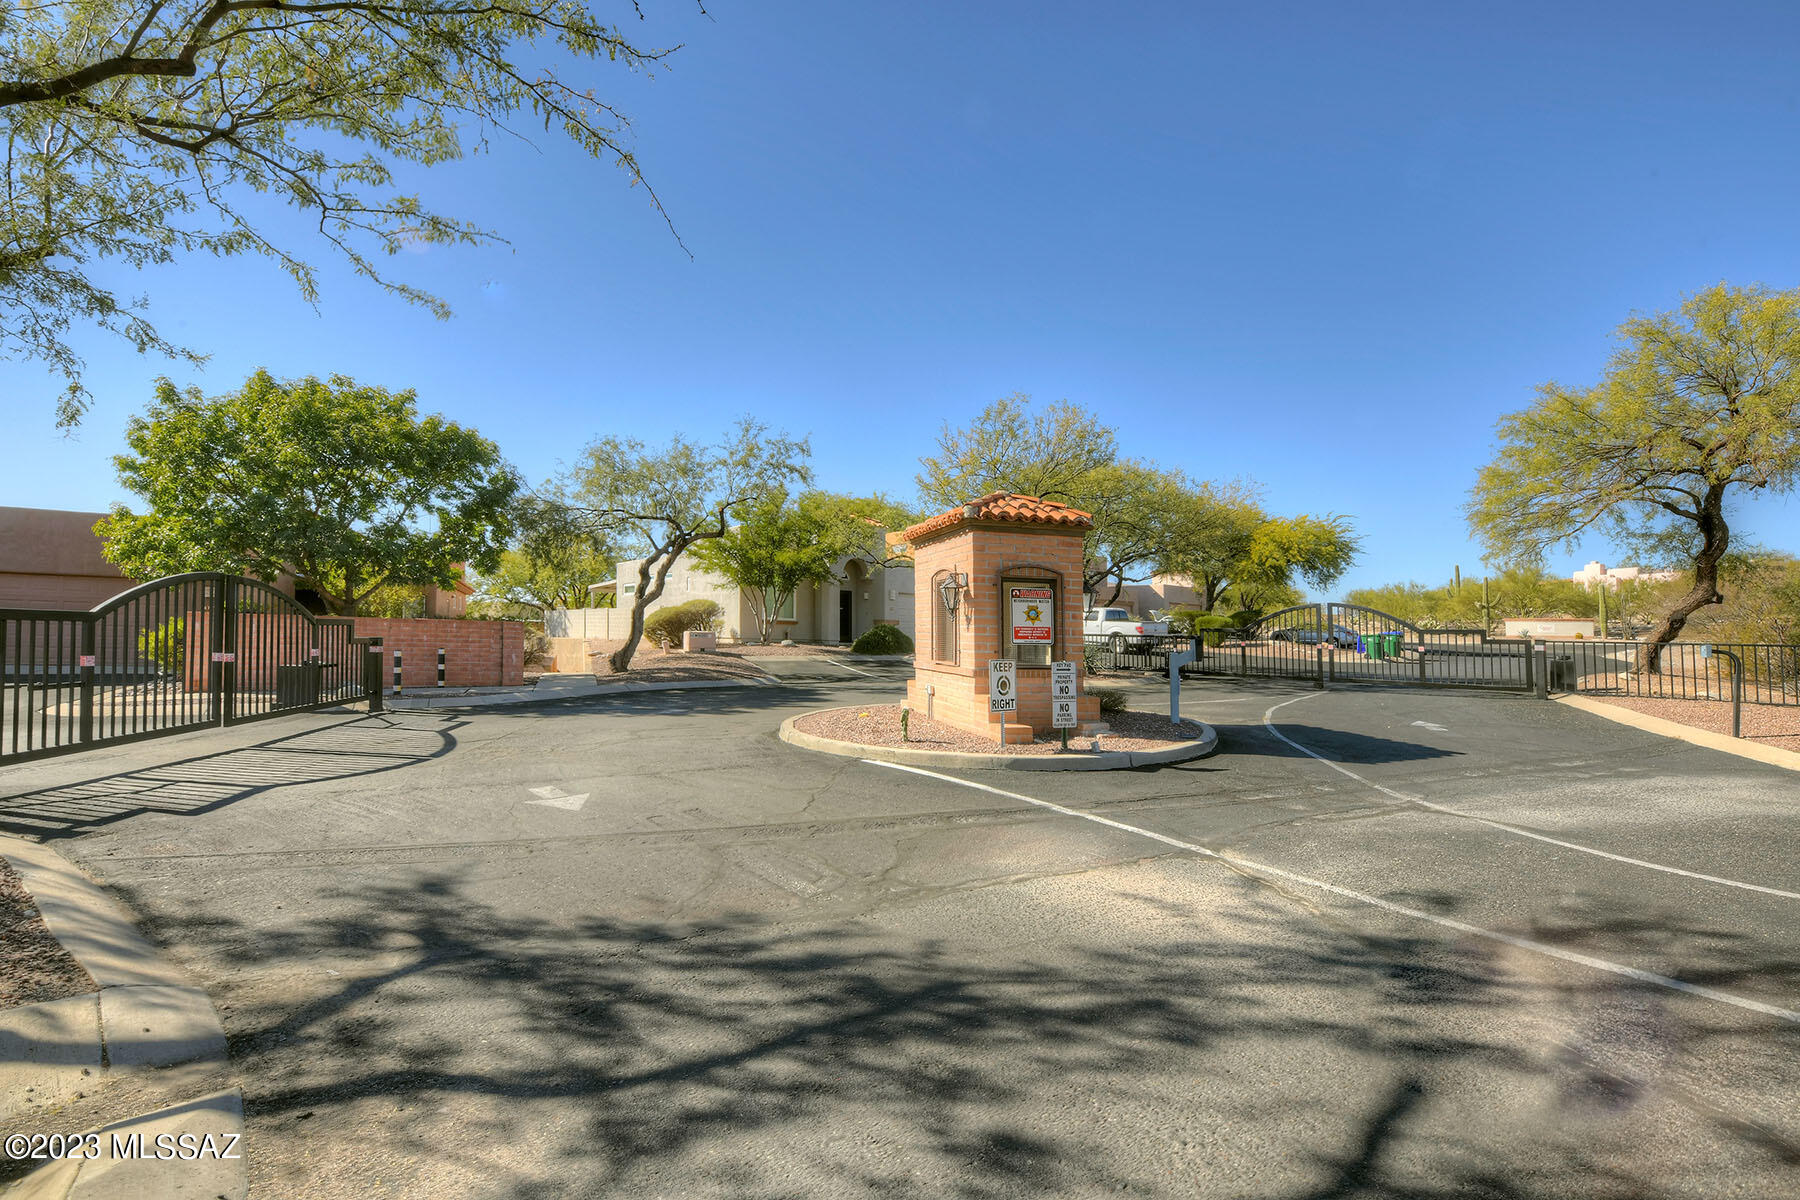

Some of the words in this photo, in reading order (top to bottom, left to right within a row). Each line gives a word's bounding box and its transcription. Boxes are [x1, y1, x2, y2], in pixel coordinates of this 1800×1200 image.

[1019, 590, 1051, 598] WARNING
[993, 662, 1013, 672] KEEP
[1059, 685, 1070, 694] NO
[992, 698, 1015, 709] RIGHT
[1059, 703, 1070, 712] NO
